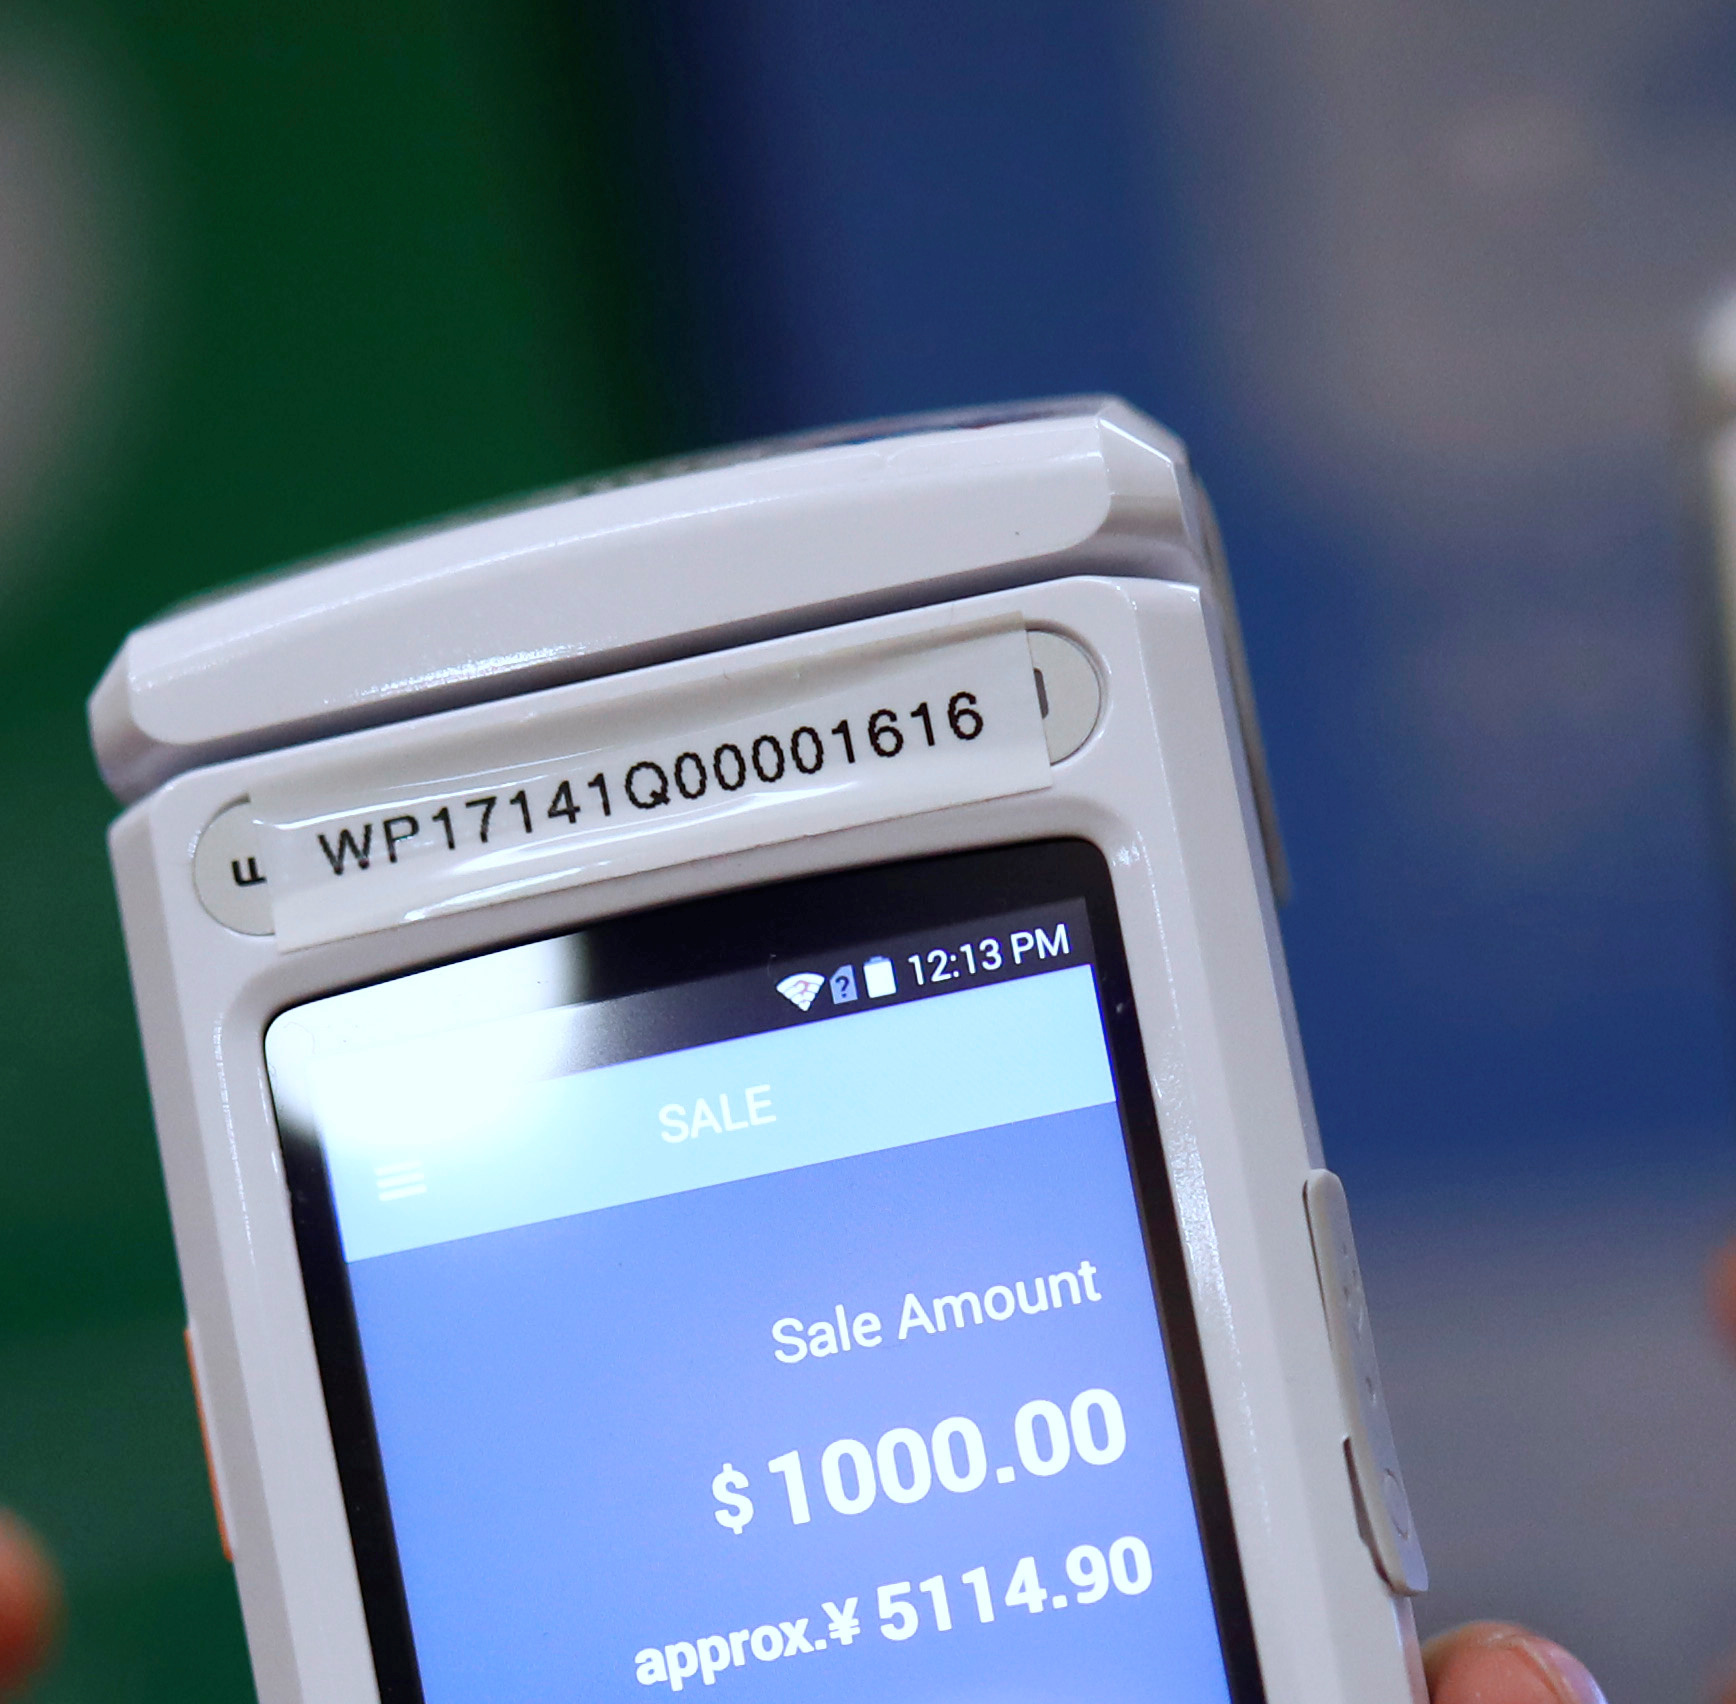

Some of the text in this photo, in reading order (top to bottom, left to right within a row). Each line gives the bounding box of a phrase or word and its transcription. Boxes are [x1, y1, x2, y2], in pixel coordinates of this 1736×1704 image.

[317, 690, 984, 876] WP17141Q00001616
[909, 924, 1069, 984] 12:13 PM
[658, 1084, 777, 1144] SALE
[772, 1261, 1101, 1363] Sale Amount
